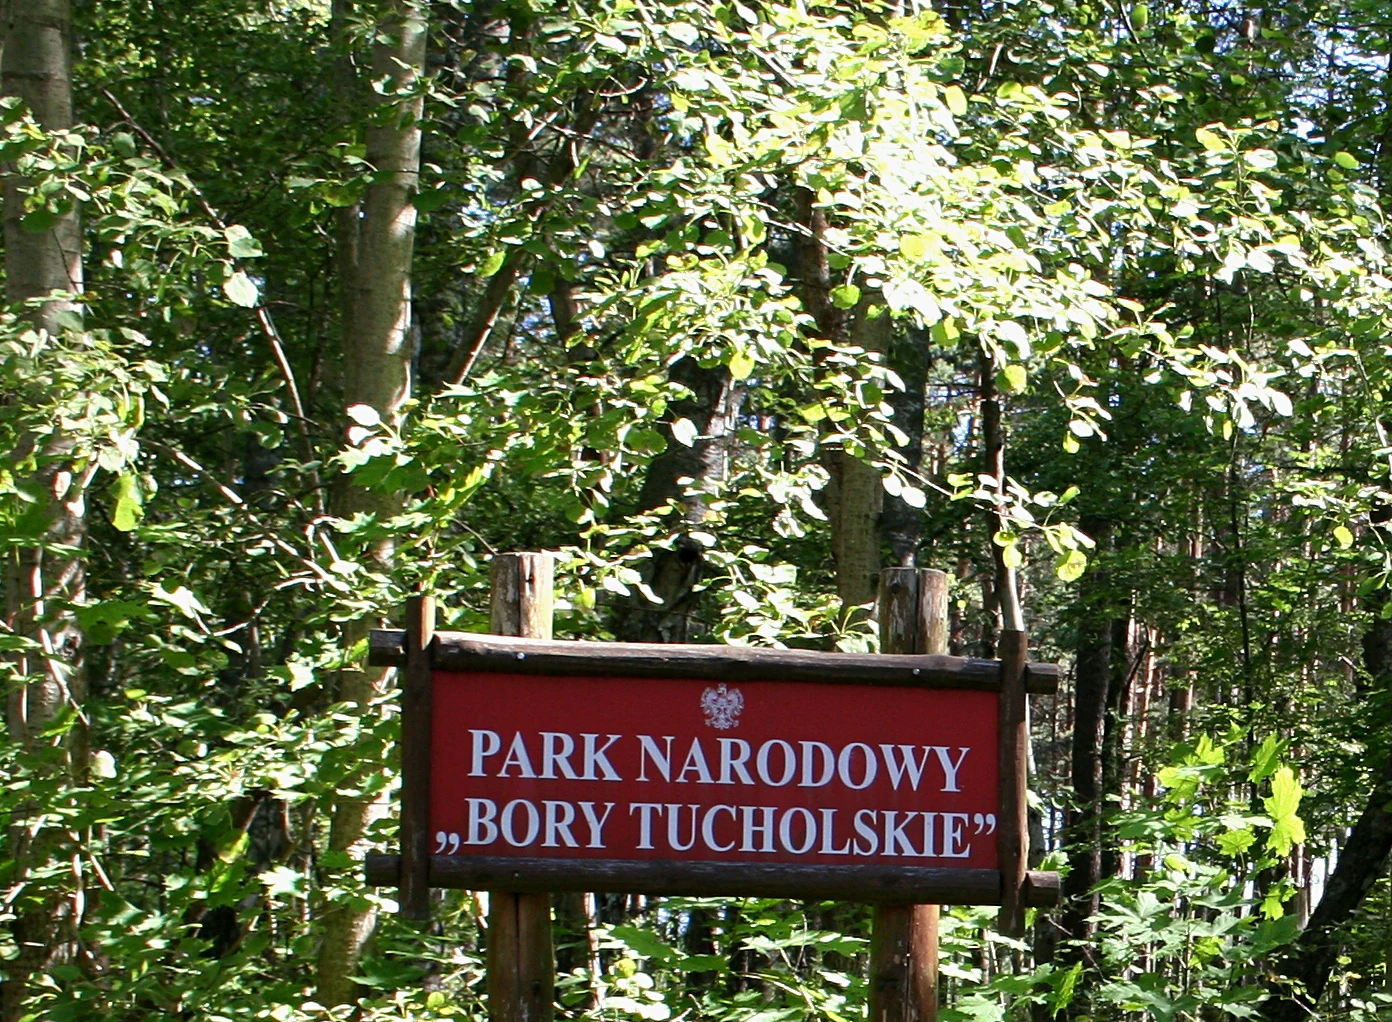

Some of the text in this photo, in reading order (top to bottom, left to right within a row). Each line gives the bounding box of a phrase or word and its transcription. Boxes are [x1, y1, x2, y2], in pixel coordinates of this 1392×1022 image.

[465, 729, 971, 793] PARK NARODOWY
[434, 796, 997, 859] „BORY TUCHOLSKIE”
